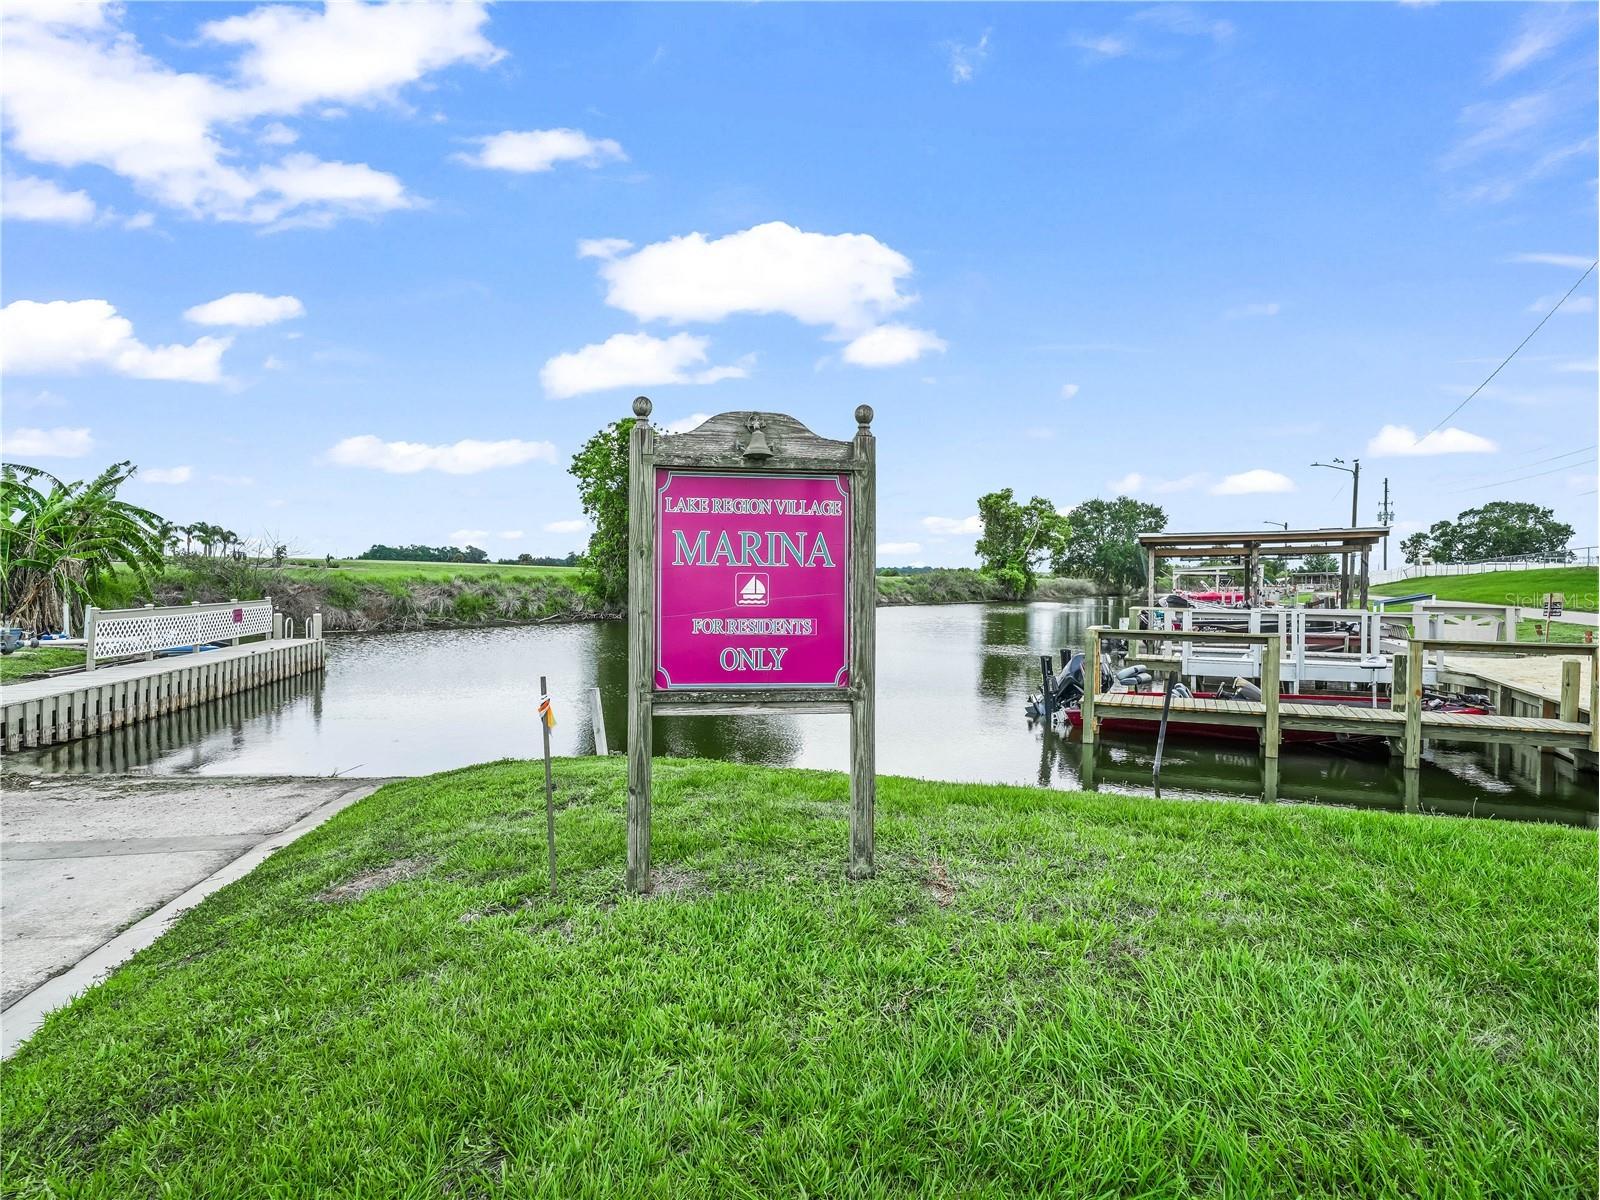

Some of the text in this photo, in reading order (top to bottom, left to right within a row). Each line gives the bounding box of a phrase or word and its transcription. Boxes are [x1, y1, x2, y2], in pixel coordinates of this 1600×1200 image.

[665, 497, 842, 516] LAKE REGION VILLAGE
[672, 530, 836, 568] MARINA
[692, 618, 812, 635] FOR RESIDENTS
[719, 647, 788, 671] ONLY
